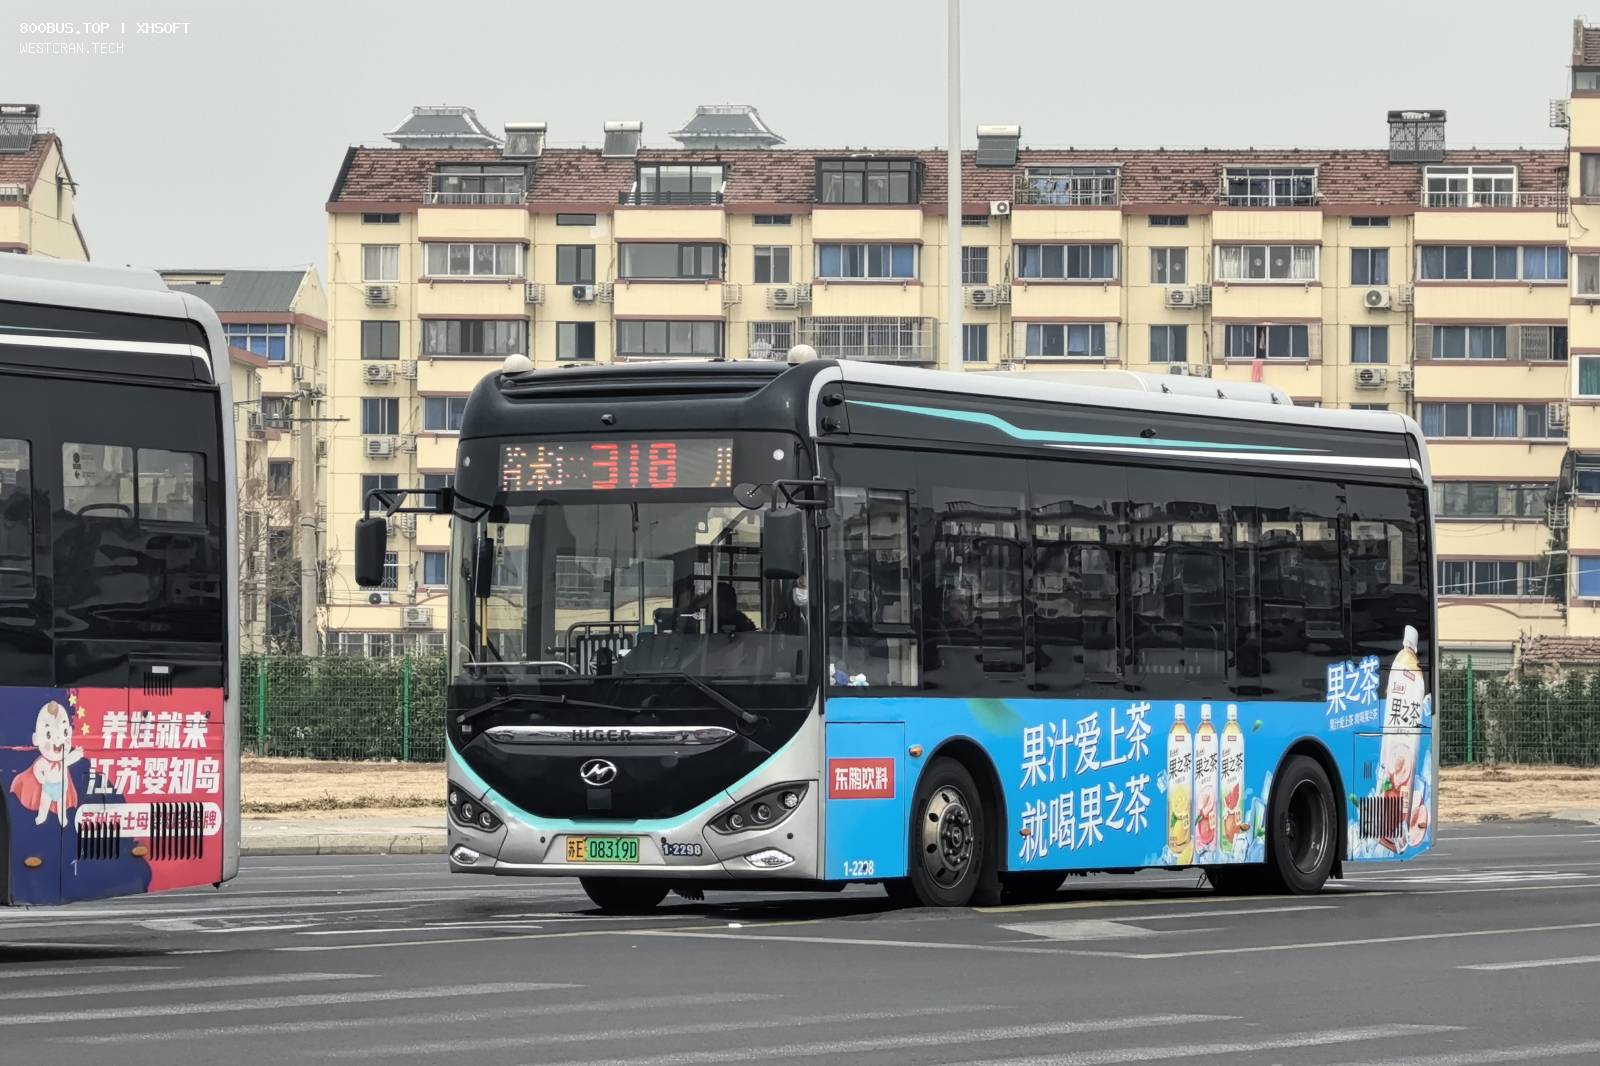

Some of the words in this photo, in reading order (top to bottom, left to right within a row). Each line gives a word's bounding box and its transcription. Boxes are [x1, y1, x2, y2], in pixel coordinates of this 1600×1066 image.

[591, 442, 677, 489] 318
[1326, 657, 1380, 716] 果之茶
[1389, 698, 1420, 727] 果之茶
[102, 711, 208, 749] 养娃就来
[572, 729, 632, 741] HIGER
[1019, 701, 1151, 790] 果汁爱上茶
[835, 767, 888, 790] 东鹏饮料
[1168, 753, 1191, 780] 果之茶
[1195, 753, 1217, 780] 果之茶
[1221, 753, 1243, 780] 果之茶
[1019, 774, 1150, 862] 就喝果之茶
